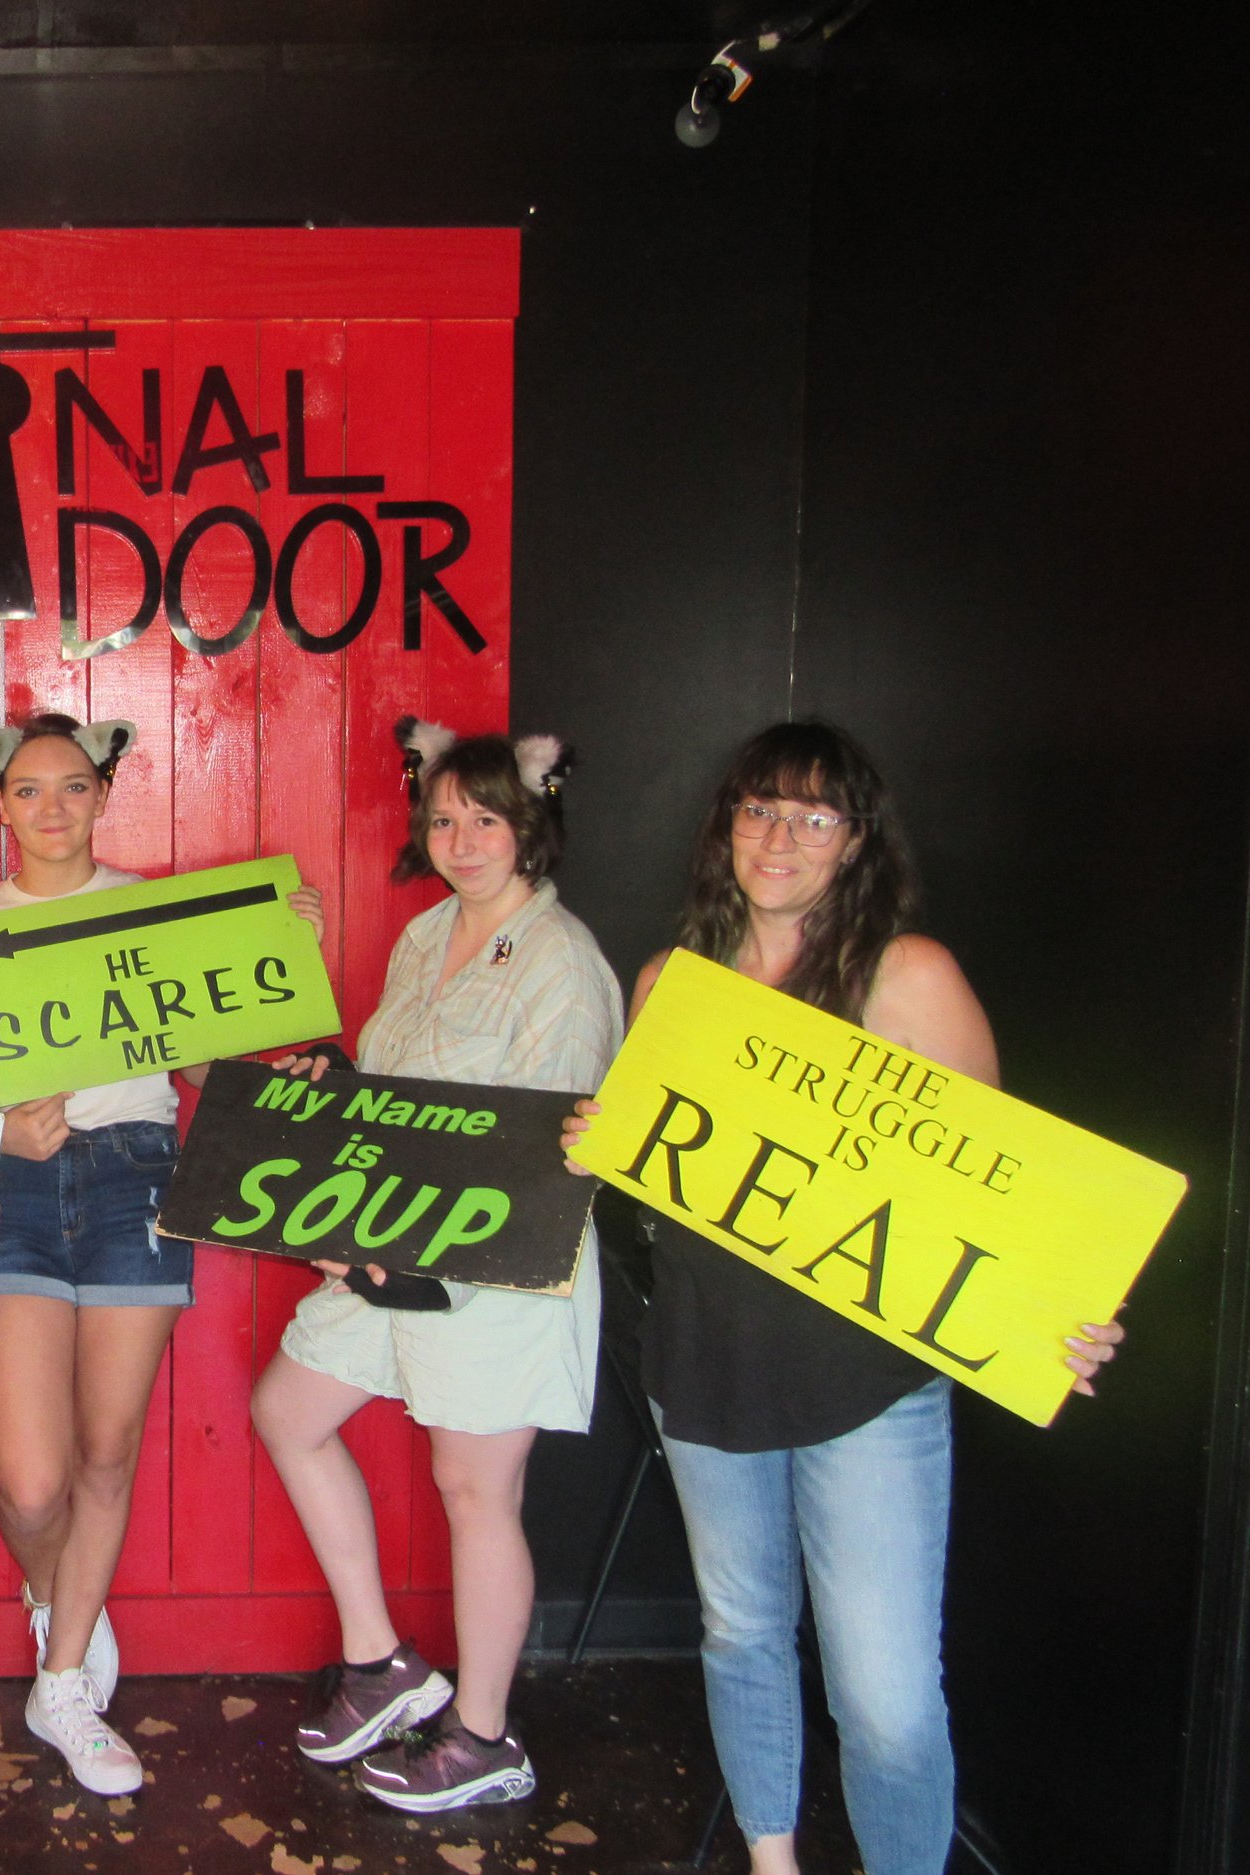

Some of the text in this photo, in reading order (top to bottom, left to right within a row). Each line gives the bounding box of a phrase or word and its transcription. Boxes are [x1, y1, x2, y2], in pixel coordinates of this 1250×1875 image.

[56, 501, 488, 661] DOOR
[104, 946, 154, 982] HE
[121, 1031, 181, 1070] ME
[842, 1035, 950, 1111] THE
[254, 1077, 497, 1136] My Name
[734, 1034, 1023, 1195] STRUGGLE
[332, 1134, 384, 1169] is
[823, 1124, 878, 1173] IS
[211, 1158, 511, 1267] SOUP
[614, 1083, 1000, 1374] REAL
